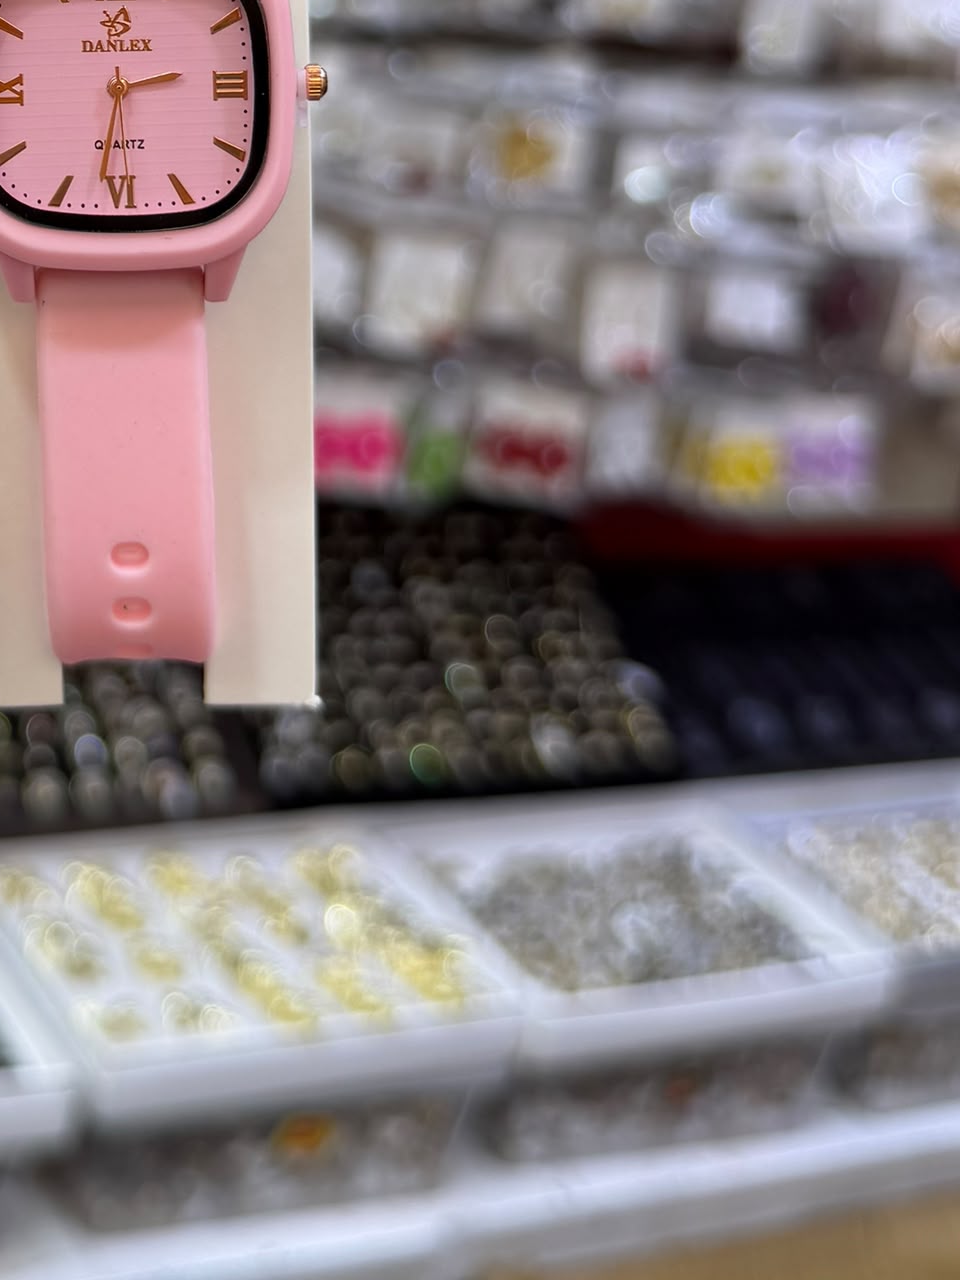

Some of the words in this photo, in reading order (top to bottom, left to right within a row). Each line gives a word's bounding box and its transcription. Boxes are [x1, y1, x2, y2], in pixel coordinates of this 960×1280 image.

[81, 39, 152, 53] DANLEX
[212, 70, 248, 101] III
[94, 139, 145, 150] QARTZ
[104, 175, 137, 209] VI
